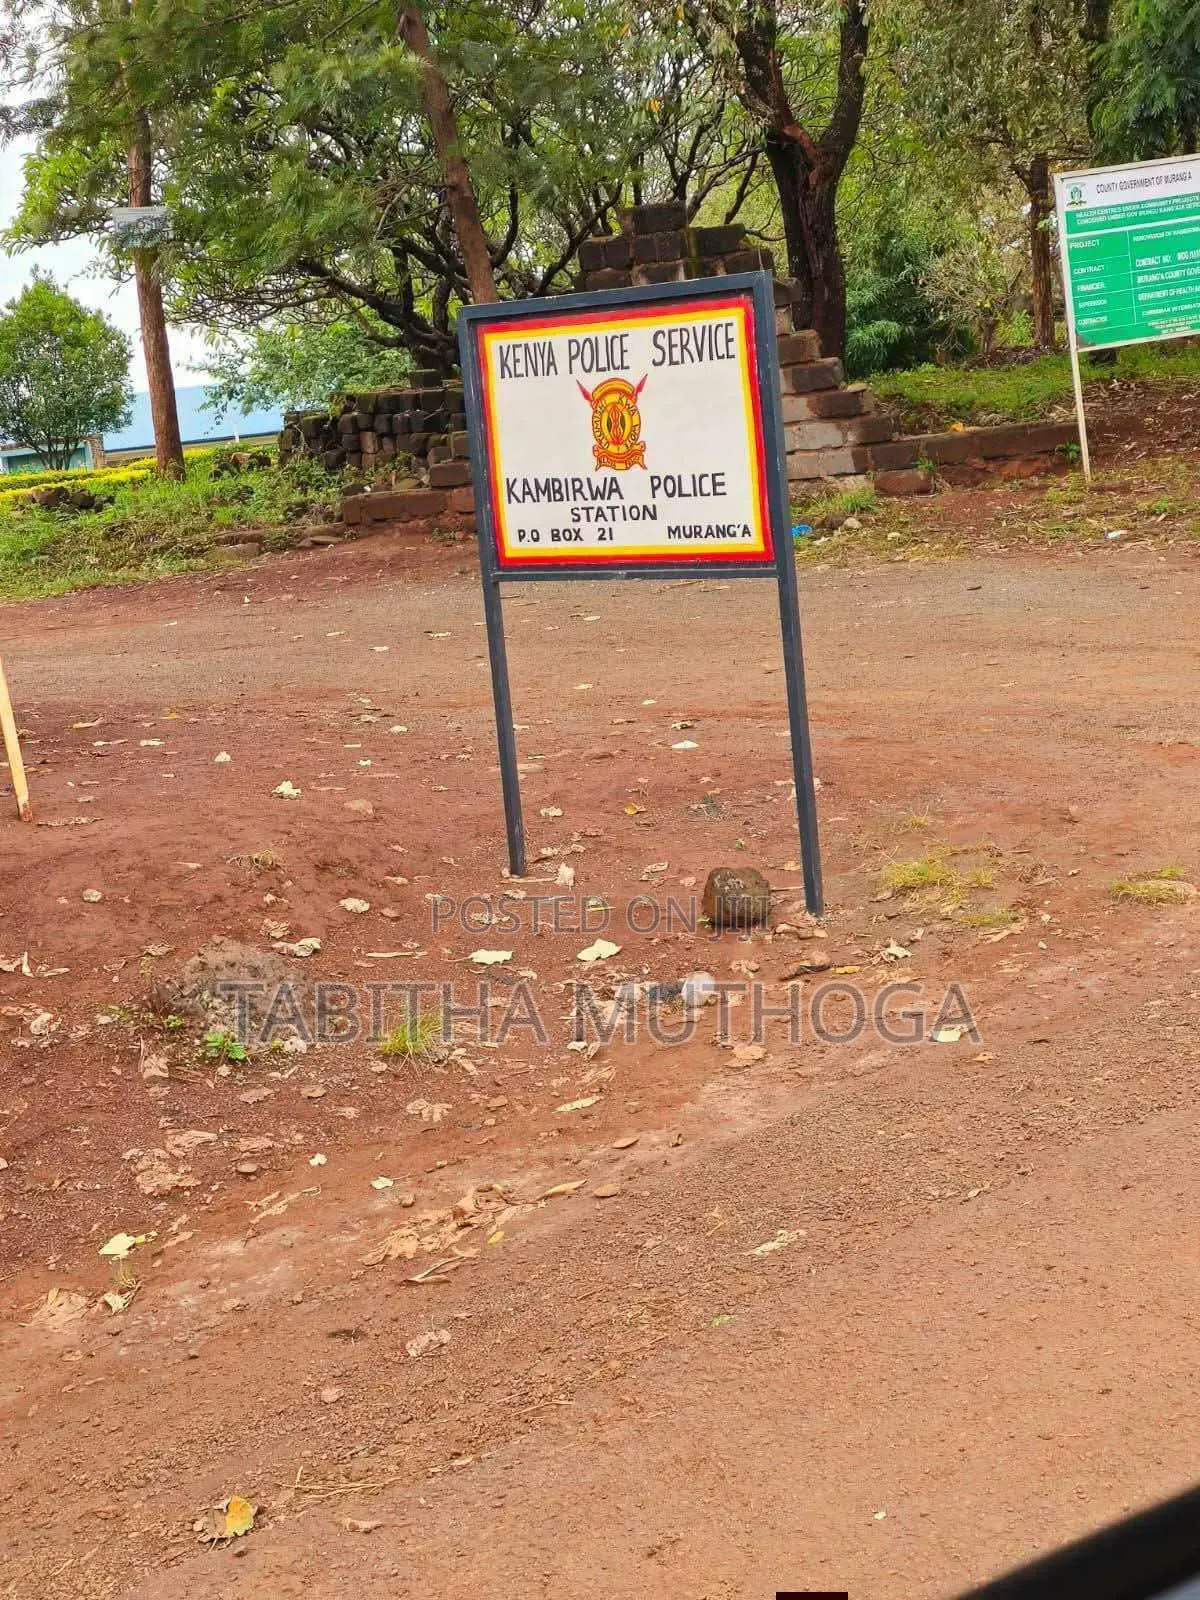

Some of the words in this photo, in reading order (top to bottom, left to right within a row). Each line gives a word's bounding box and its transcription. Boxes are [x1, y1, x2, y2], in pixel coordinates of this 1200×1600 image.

[1096, 181, 1118, 194] COUNTY
[1119, 177, 1155, 191] GOVERNMENT
[1156, 175, 1163, 186] OF
[1069, 239, 1100, 249] PROJECT
[1073, 264, 1105, 275] CONTRACT
[499, 340, 558, 379] KENYA
[568, 333, 630, 375] POLICE
[652, 322, 736, 367] SERVICE
[505, 475, 624, 504] KAMBIRWA
[650, 472, 727, 498] POLICE
[570, 504, 658, 523] STATION
[517, 528, 540, 543] P.O
[551, 528, 584, 542] BOX
[597, 527, 614, 541] 21
[667, 523, 752, 540] MURANG'A
